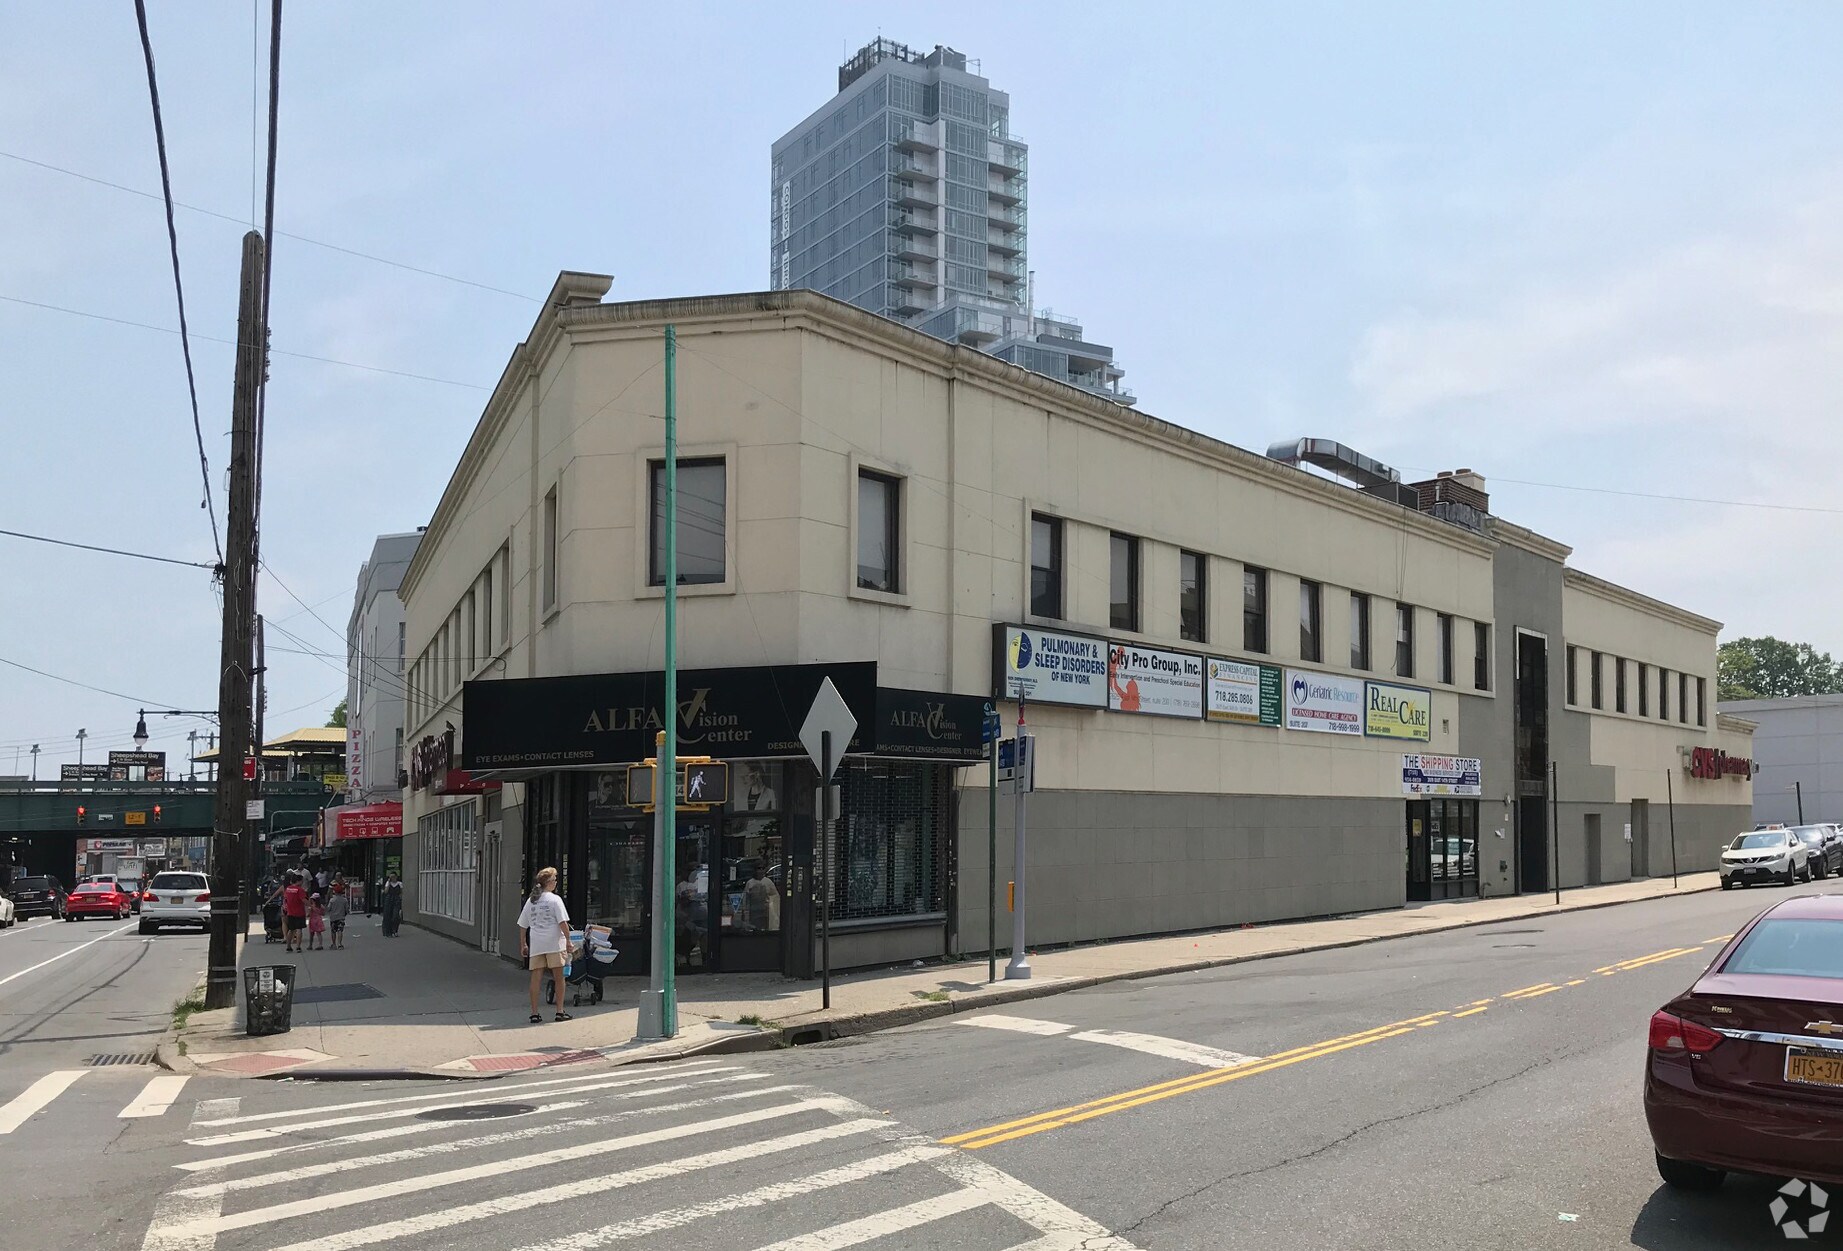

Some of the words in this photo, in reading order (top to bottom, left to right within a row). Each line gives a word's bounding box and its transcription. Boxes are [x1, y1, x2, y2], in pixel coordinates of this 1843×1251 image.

[1041, 637, 1090, 657] PULMONARY
[1092, 645, 1098, 658] &
[1035, 652, 1060, 669] SLEEP
[1062, 657, 1106, 675] DISORDERS
[1109, 649, 1130, 670] City
[1132, 652, 1149, 668] Pro
[1151, 655, 1182, 676] Group,
[1184, 659, 1201, 675] Inc.
[1051, 671, 1060, 682] OF
[1060, 672, 1074, 683] NEW
[1074, 674, 1091, 685] YORK
[1151, 676, 1170, 684] Preschool
[1170, 678, 1183, 686] Special
[1184, 680, 1201, 688] Education
[1309, 684, 1333, 700] Geriatric
[583, 706, 665, 733] ALFA
[890, 710, 926, 728] ALFA
[351, 730, 362, 788] PIZZA
[476, 755, 490, 763] EYE
[492, 754, 520, 762] EXAMS
[524, 752, 562, 761] CONTACT
[563, 750, 594, 759] LENSES
[1404, 755, 1419, 768] THE
[1421, 757, 1454, 770] SHIPPING
[1455, 759, 1477, 771] STORE
[1410, 784, 1423, 792] FedEx
[1792, 1057, 1816, 1077] HTS
